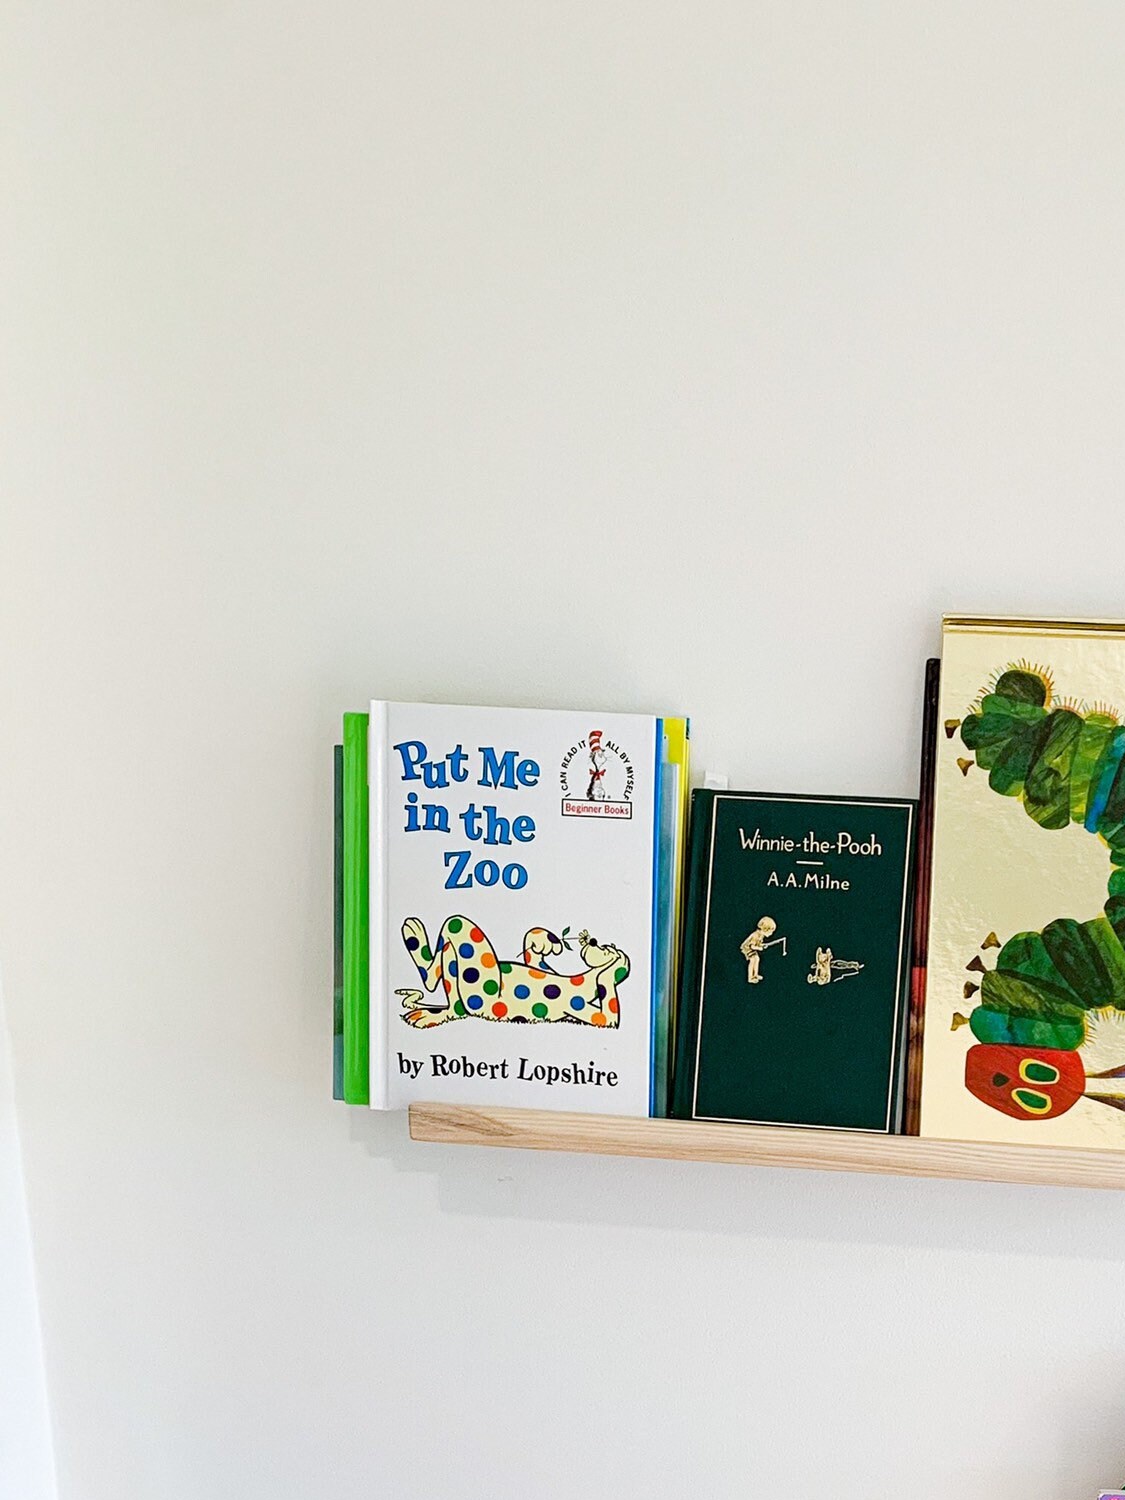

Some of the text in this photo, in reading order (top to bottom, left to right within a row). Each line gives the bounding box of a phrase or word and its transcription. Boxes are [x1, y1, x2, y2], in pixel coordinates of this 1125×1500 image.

[561, 746, 578, 769] READ
[578, 740, 586, 749] IT
[605, 740, 620, 754] ALL
[393, 740, 541, 791] Put Me
[619, 752, 631, 764] BY
[559, 771, 569, 791] CAN
[623, 766, 635, 801] MYSELF
[404, 792, 536, 845] in the
[565, 802, 629, 815] Beginner Books
[738, 827, 883, 857] Winnie-the-Pooh
[444, 850, 529, 890] Zoo
[396, 1052, 619, 1088] by Robert Lopshire
